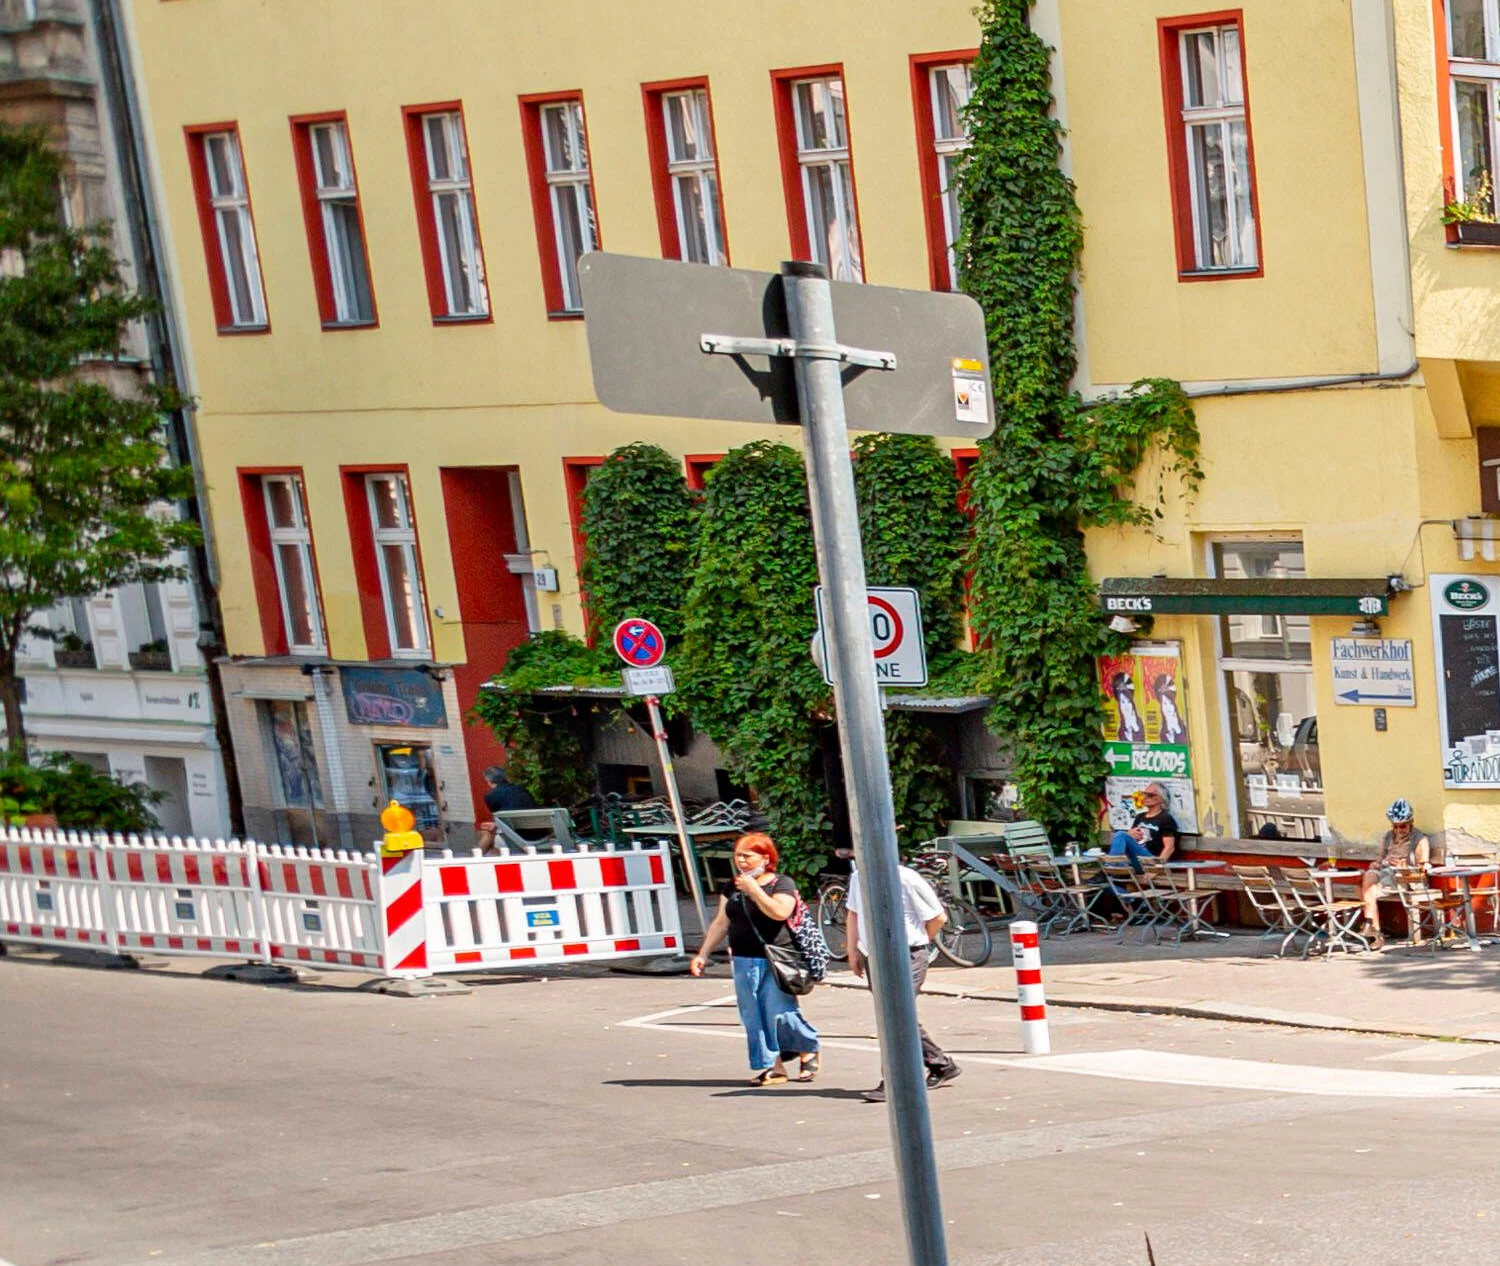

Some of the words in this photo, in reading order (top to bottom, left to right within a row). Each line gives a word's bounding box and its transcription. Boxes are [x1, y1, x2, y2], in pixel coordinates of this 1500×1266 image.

[1107, 596, 1153, 611] BECK'S
[872, 612, 891, 641] 0
[1332, 639, 1410, 660] Fachwerkhof
[876, 662, 902, 678] NE
[1334, 666, 1358, 679] Kunst
[1360, 666, 1368, 680] &
[1371, 666, 1412, 681] Handwerk
[1131, 749, 1187, 774] RECORDS
